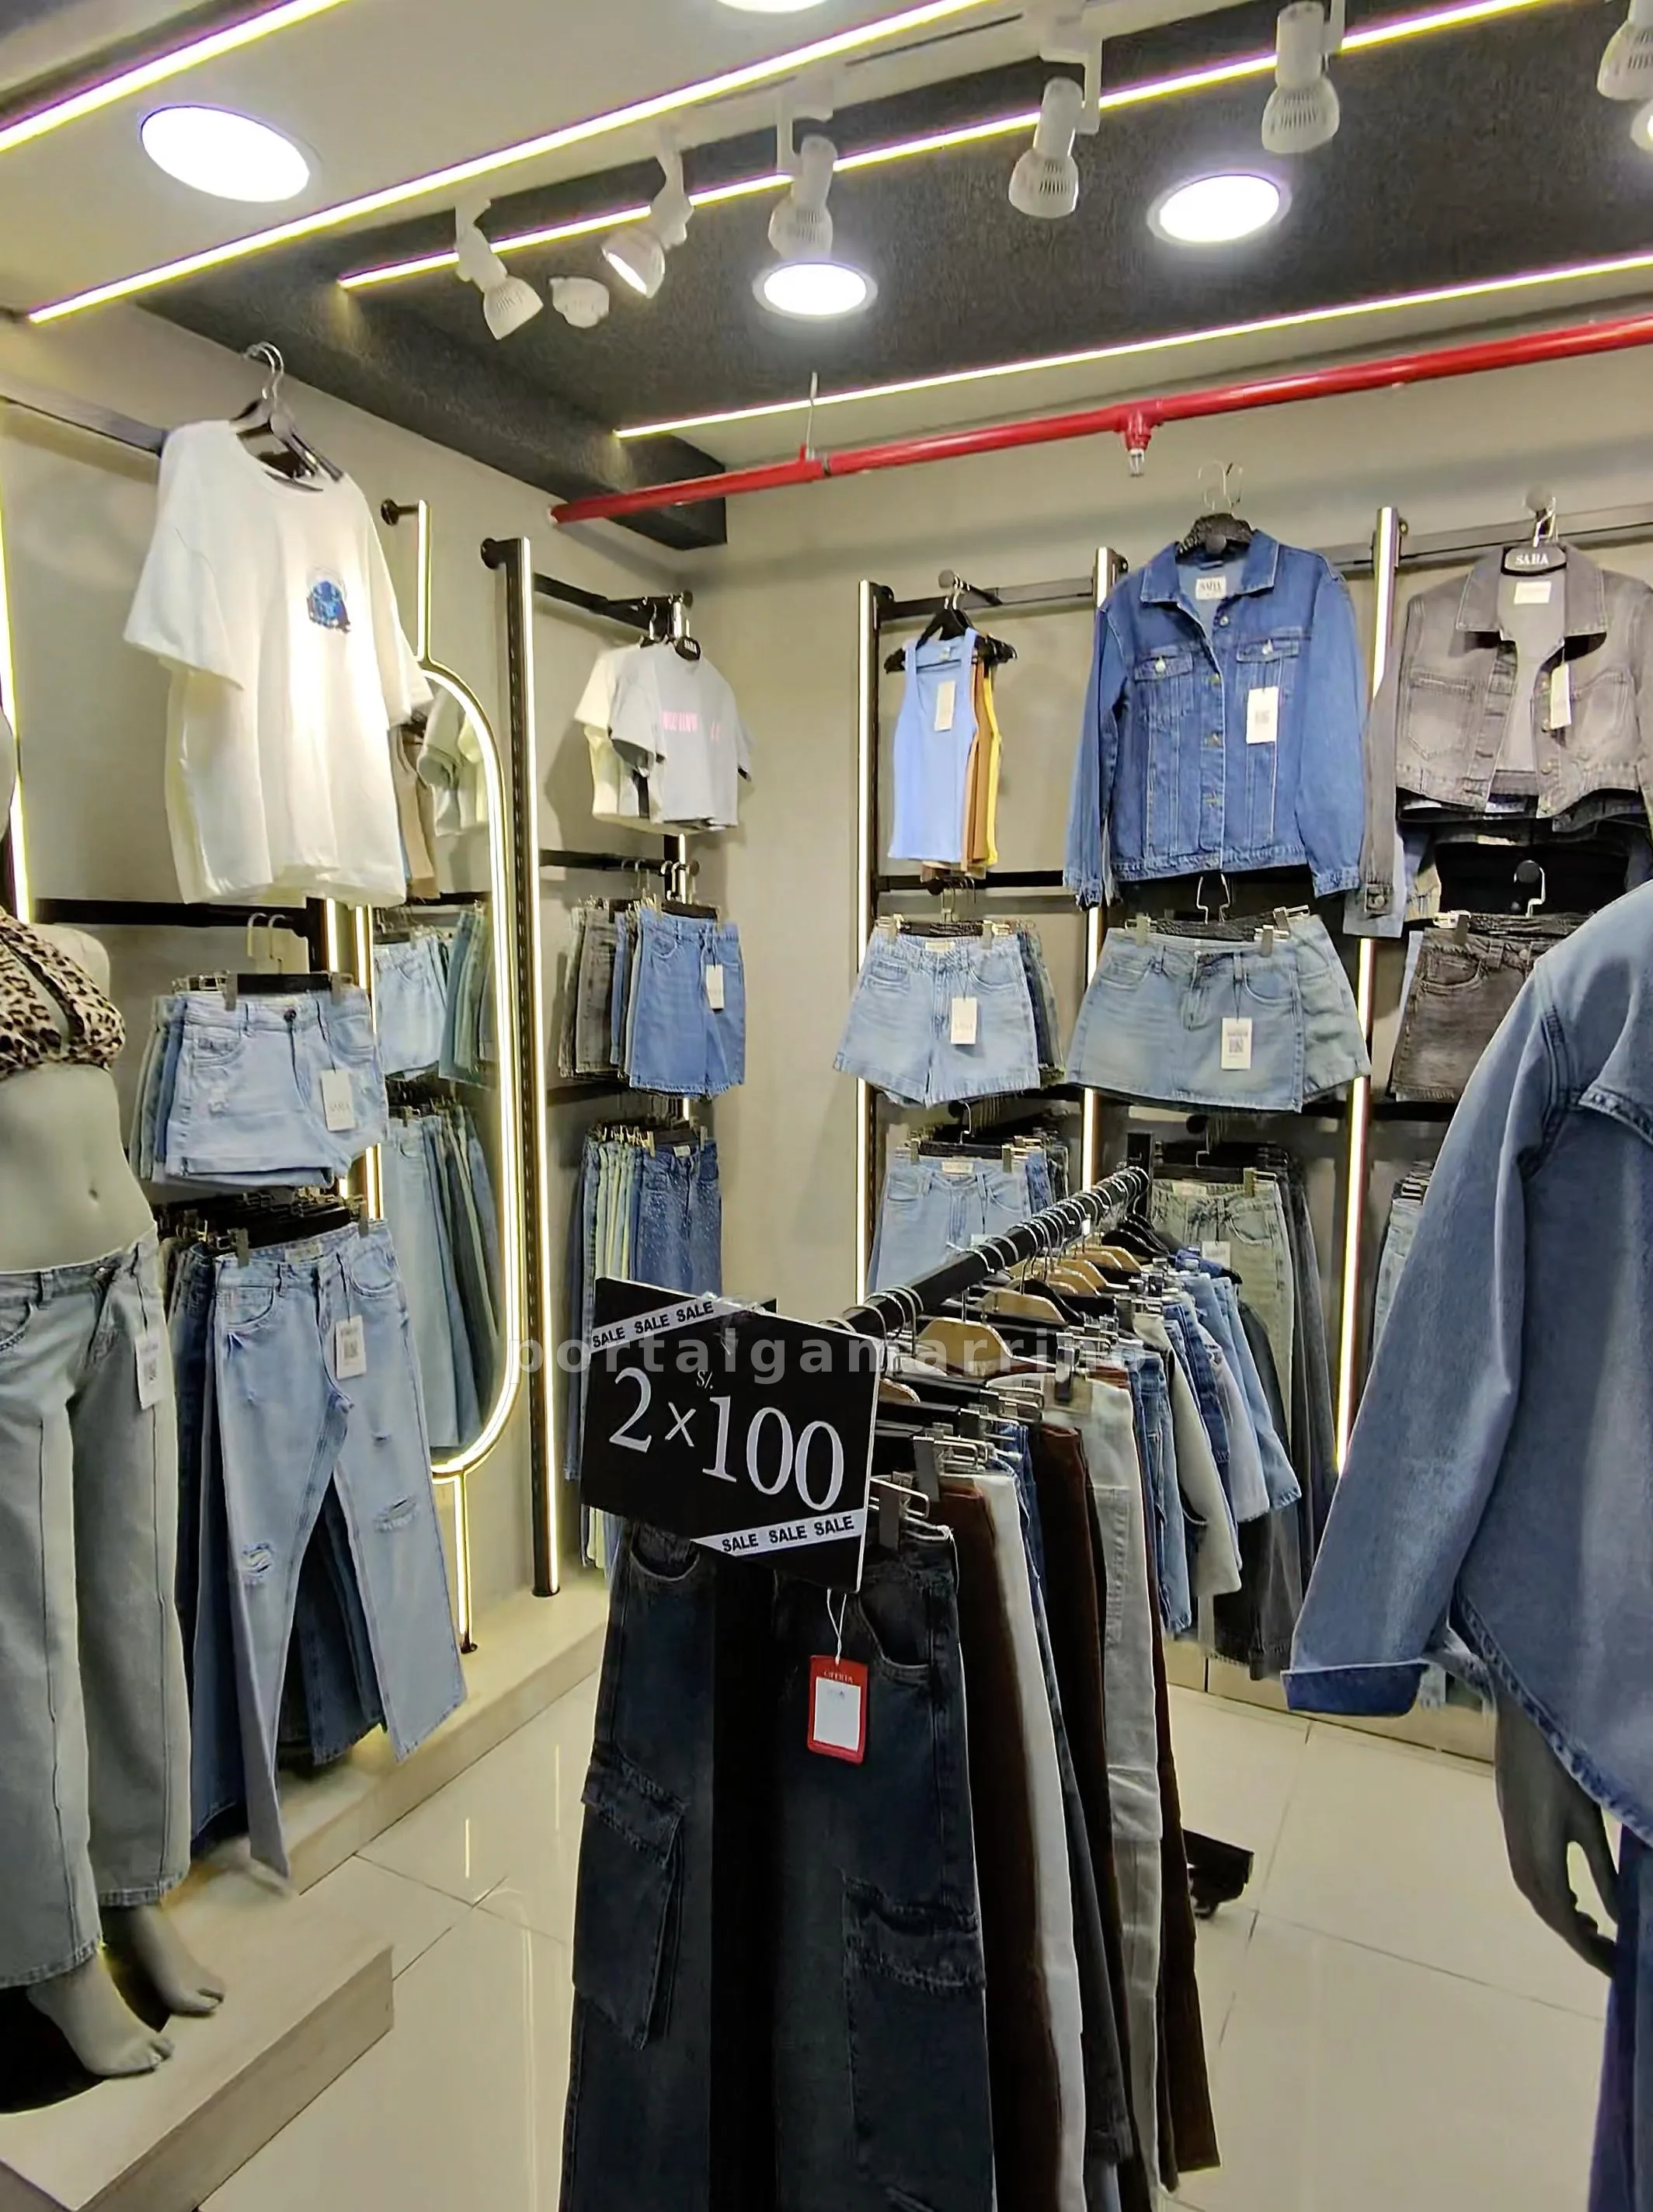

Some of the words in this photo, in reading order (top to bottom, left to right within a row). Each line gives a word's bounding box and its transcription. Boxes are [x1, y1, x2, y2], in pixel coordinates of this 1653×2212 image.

[592, 1327, 625, 1348] SALE
[634, 1313, 670, 1334] SALE
[676, 1300, 715, 1323] SALE
[609, 1366, 652, 1454] 2
[701, 1395, 844, 1511] 100
[722, 1533, 759, 1553] SALE
[768, 1525, 807, 1544] SALE
[814, 1515, 854, 1536] SALE
